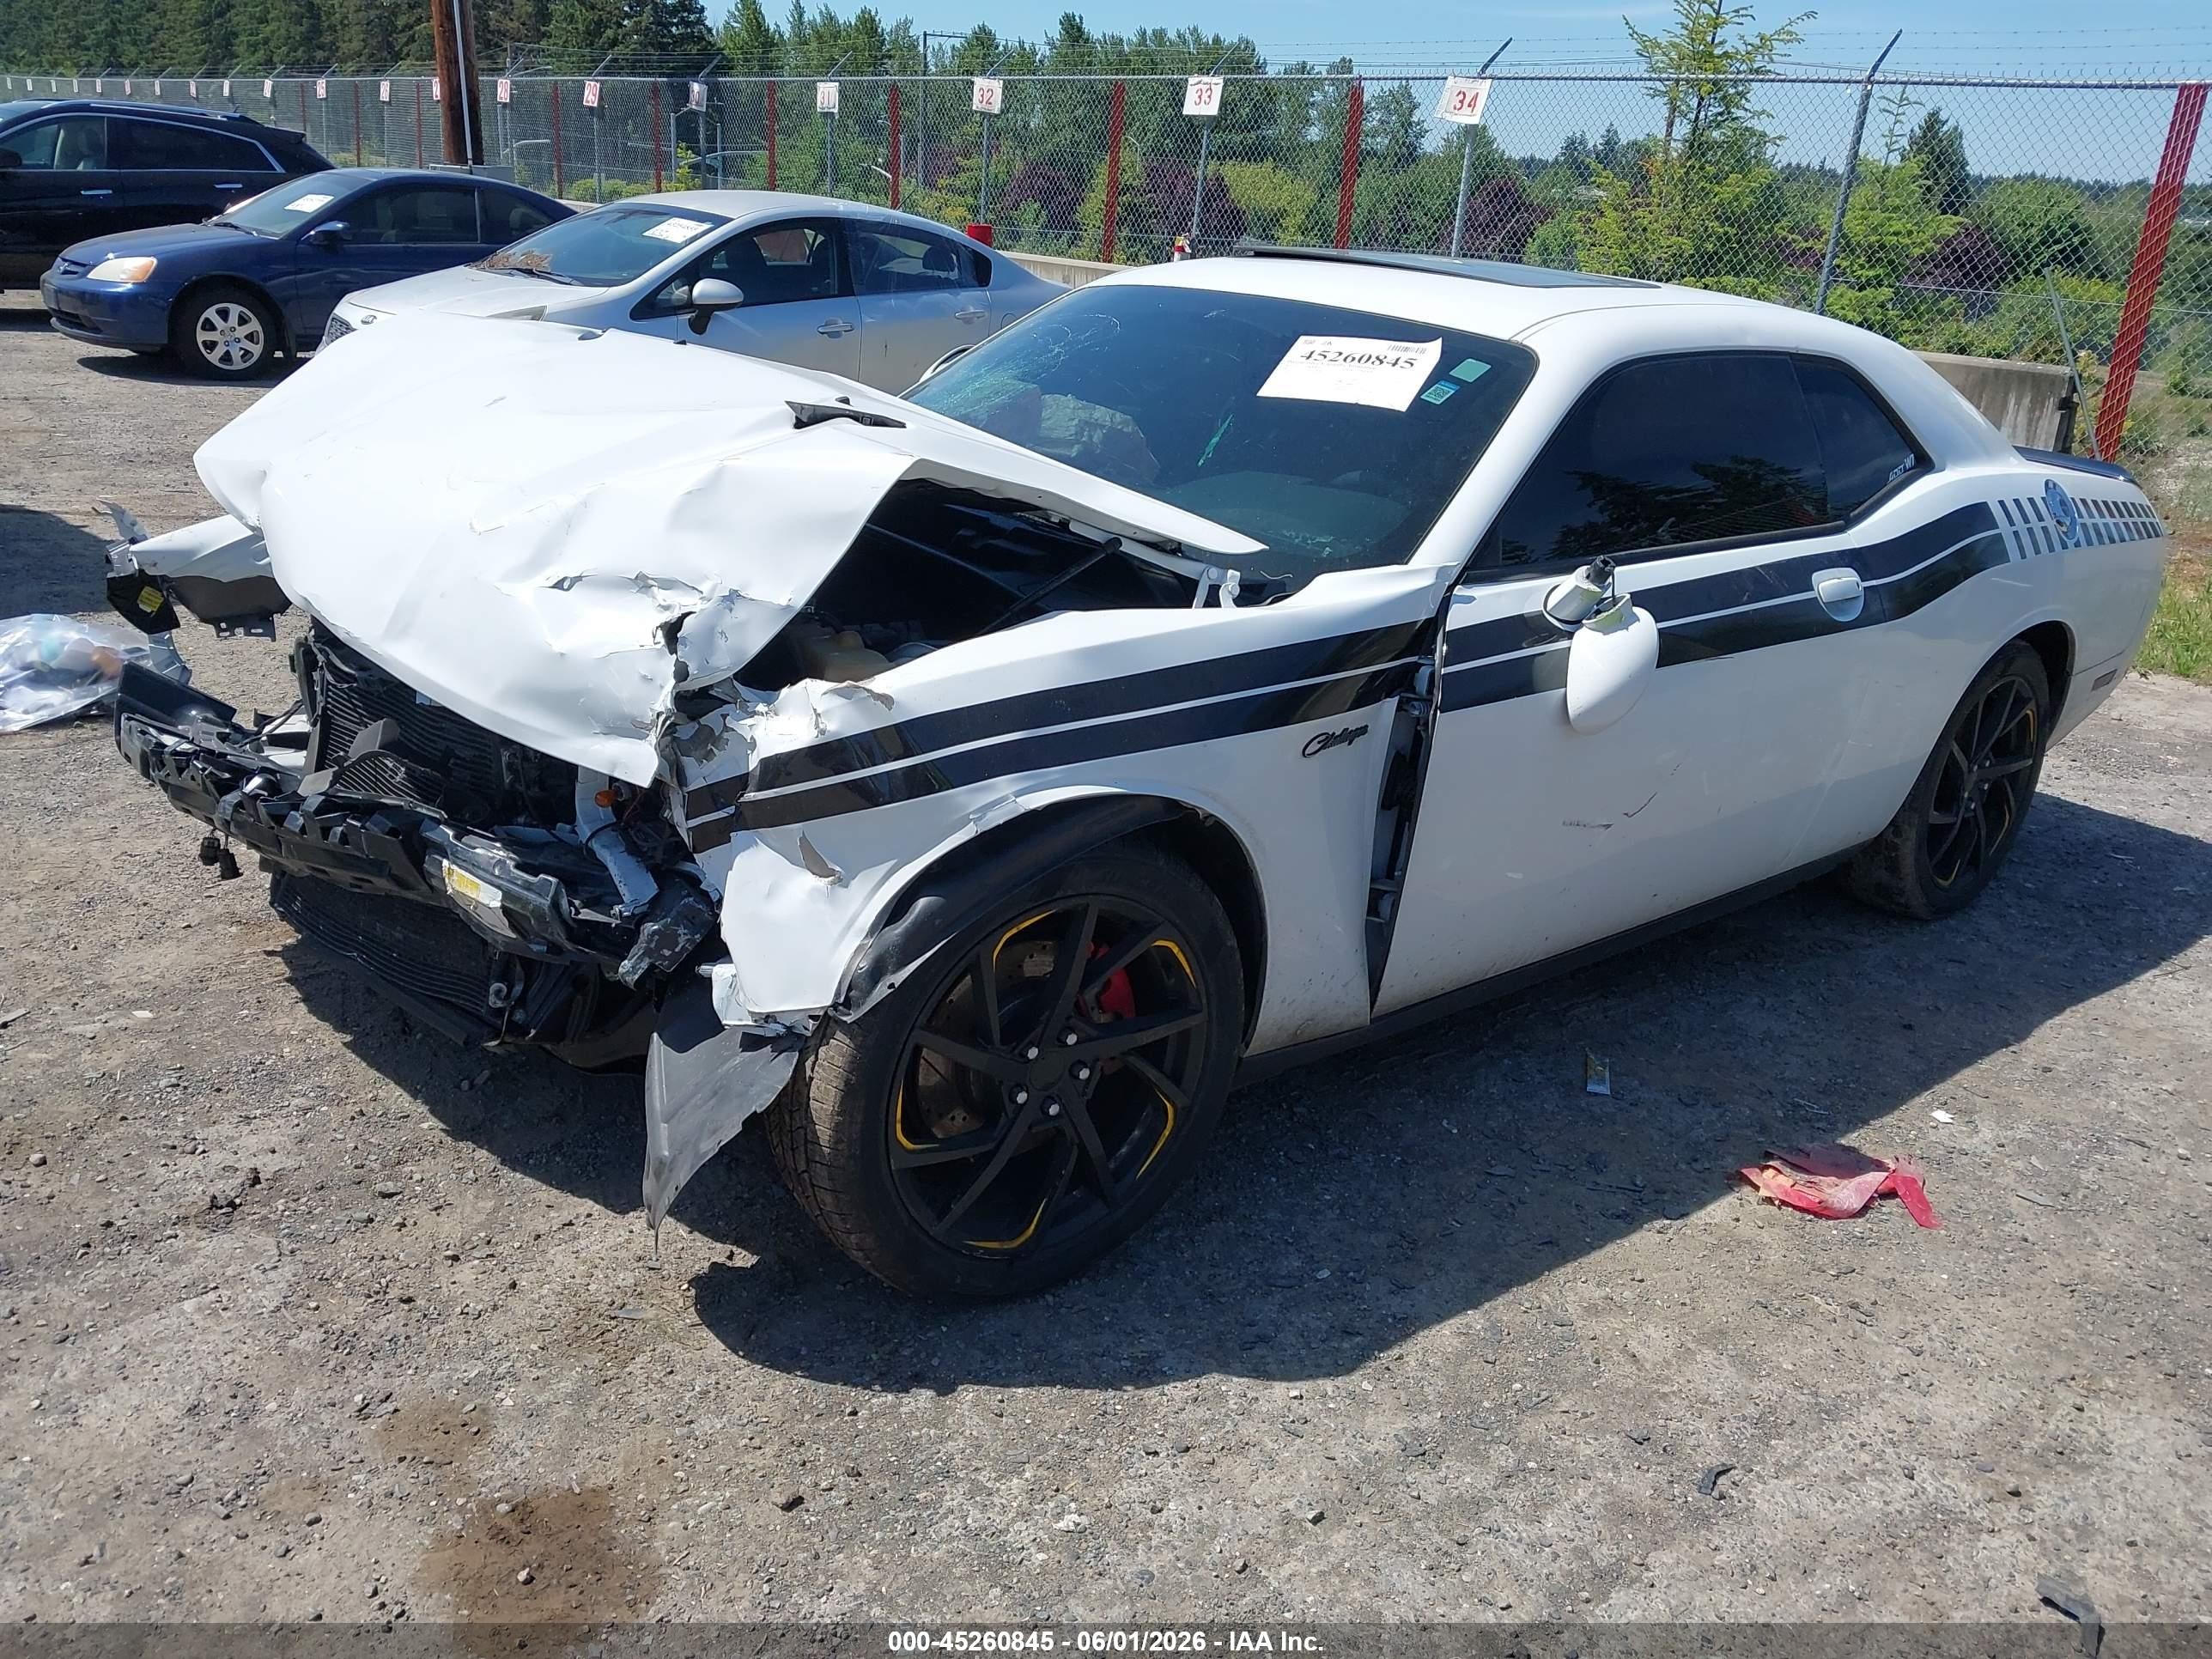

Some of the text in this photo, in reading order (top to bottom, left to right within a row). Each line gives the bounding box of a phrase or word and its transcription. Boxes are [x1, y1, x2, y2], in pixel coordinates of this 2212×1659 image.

[318, 82, 325, 97] 25
[381, 82, 389, 100] 26
[499, 81, 508, 100] 28
[584, 82, 599, 105] 29
[690, 89, 700, 104] 30
[820, 88, 831, 104] 31
[978, 88, 994, 106] 32
[1194, 87, 1212, 106] 33
[1452, 89, 1480, 114] 34
[1300, 349, 1419, 369] 45260845
